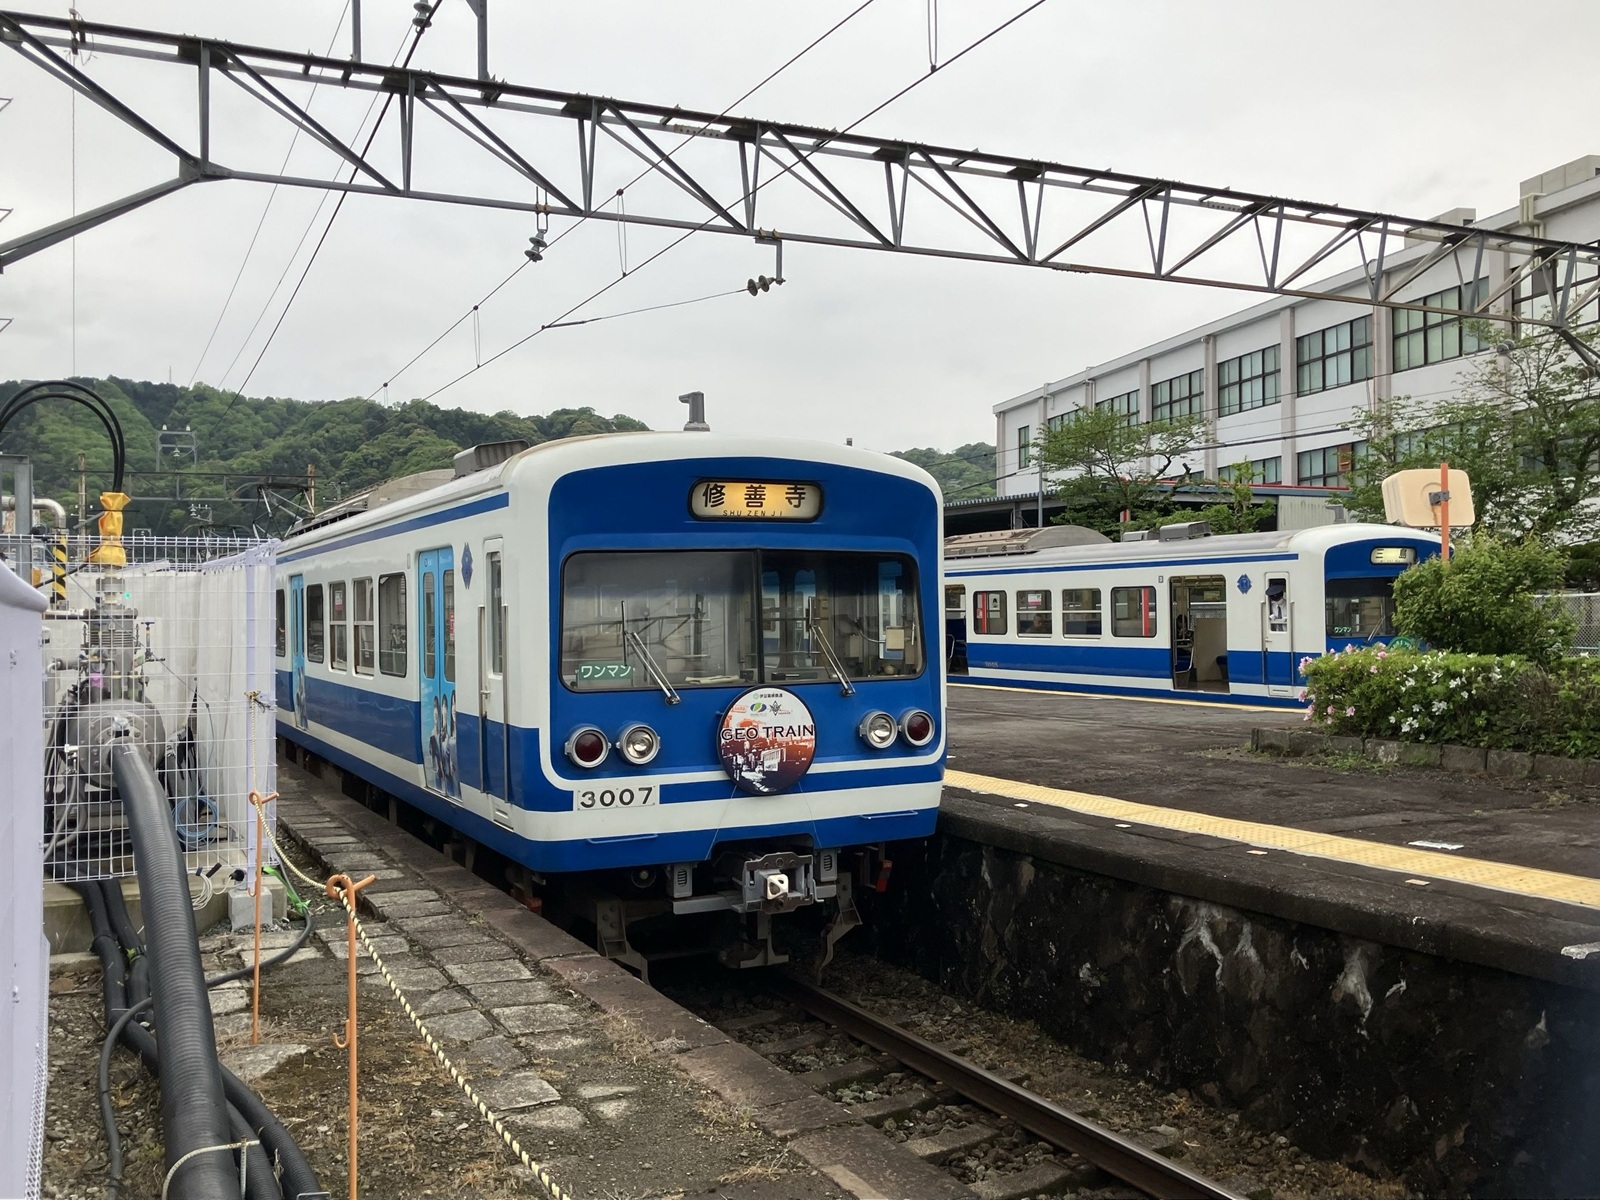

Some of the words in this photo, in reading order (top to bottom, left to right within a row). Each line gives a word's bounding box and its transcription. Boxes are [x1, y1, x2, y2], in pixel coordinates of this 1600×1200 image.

[702, 483, 806, 508] 修善寺
[581, 665, 632, 678] ワンマン
[721, 727, 758, 741] GEO
[762, 724, 814, 738] TRAIN
[580, 786, 653, 808] 3007
